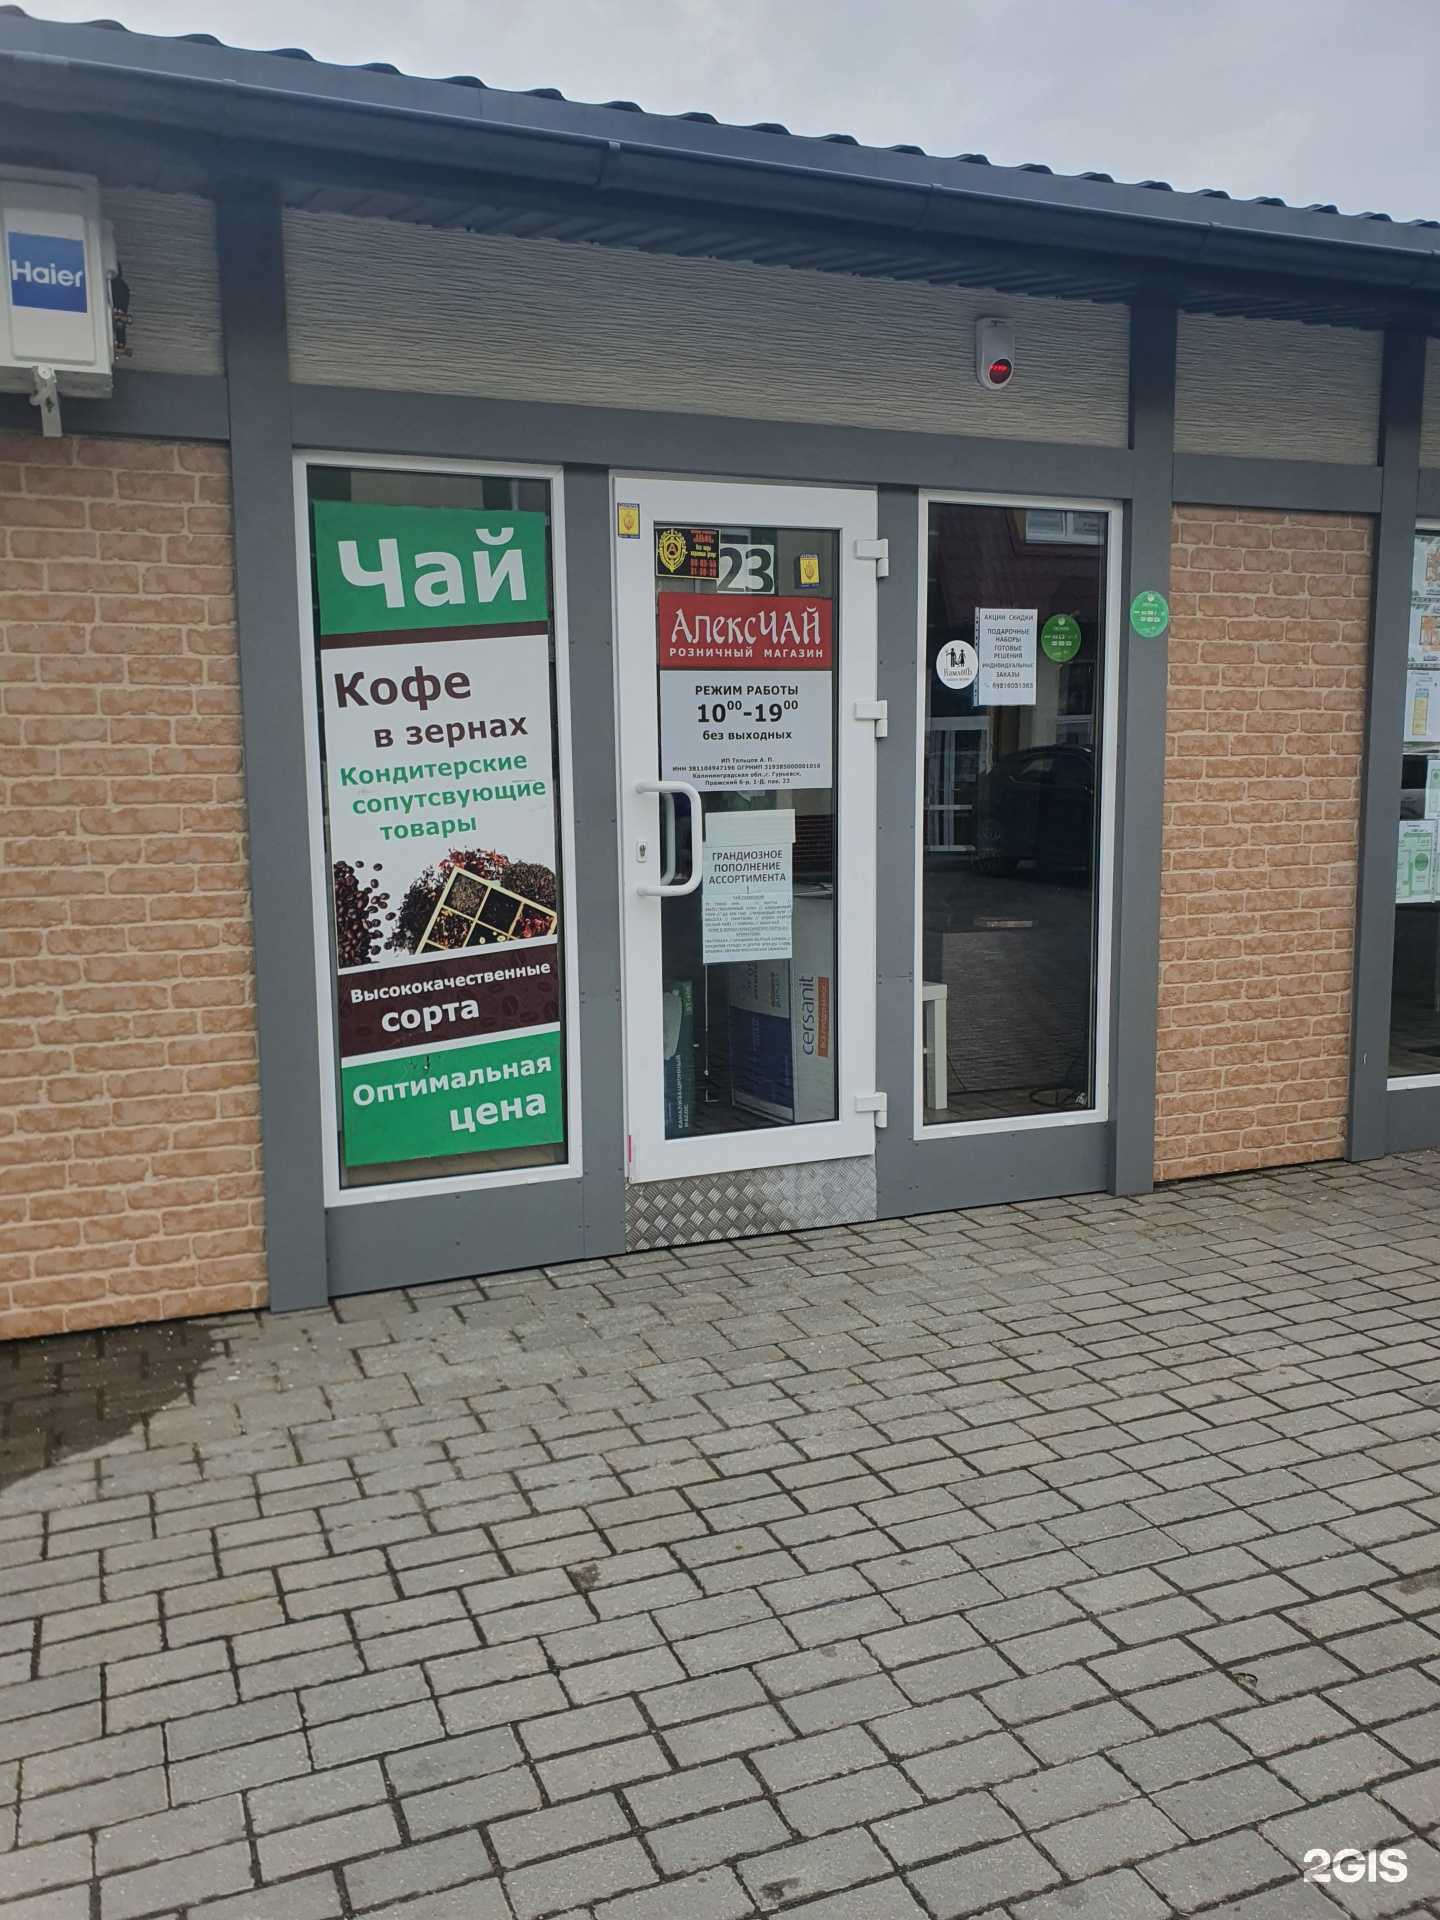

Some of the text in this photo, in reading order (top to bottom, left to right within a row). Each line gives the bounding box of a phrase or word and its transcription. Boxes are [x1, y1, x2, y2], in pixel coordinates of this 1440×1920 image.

[11, 259, 83, 287] Haier
[337, 527, 527, 609] Чай
[717, 547, 774, 592] 23
[669, 646, 823, 658] РОЗНИЧНЫЙ МАГАЗИН
[334, 666, 471, 711] Кофе
[695, 685, 799, 696] РЕЖИМ РАБОТЫ
[374, 716, 528, 748] в зернах
[702, 730, 792, 741] без выходных
[340, 754, 528, 786] Кондитерские
[352, 781, 546, 814] сопутсвующие
[380, 817, 477, 840] товары
[712, 849, 783, 861] ГРАНДИОЗНОЕ
[714, 862, 781, 873] ПОПОЛНЕНИЕ
[708, 873, 786, 885] АССОРТИМЕНТА
[351, 963, 551, 1003] Высококачественные
[381, 999, 480, 1033] сорта
[799, 975, 815, 1056] cersanit
[353, 1056, 552, 1106] Оптимальная
[450, 1092, 547, 1133] цена
